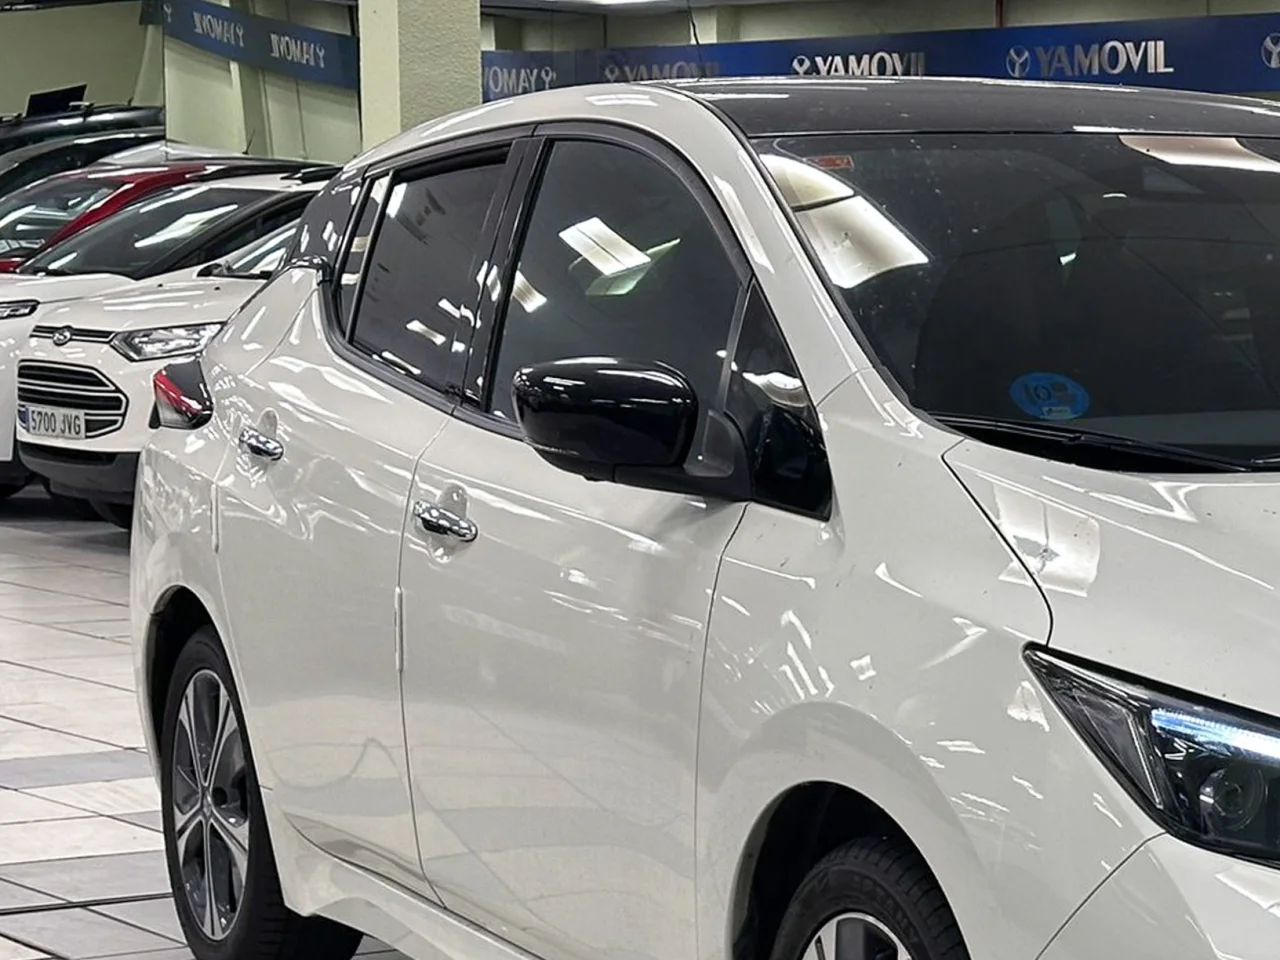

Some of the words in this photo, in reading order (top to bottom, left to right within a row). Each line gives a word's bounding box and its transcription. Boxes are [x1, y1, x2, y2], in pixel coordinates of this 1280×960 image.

[1036, 39, 1175, 77] YAMOVIL
[31, 409, 57, 433] 5700
[60, 413, 81, 435] JVG
